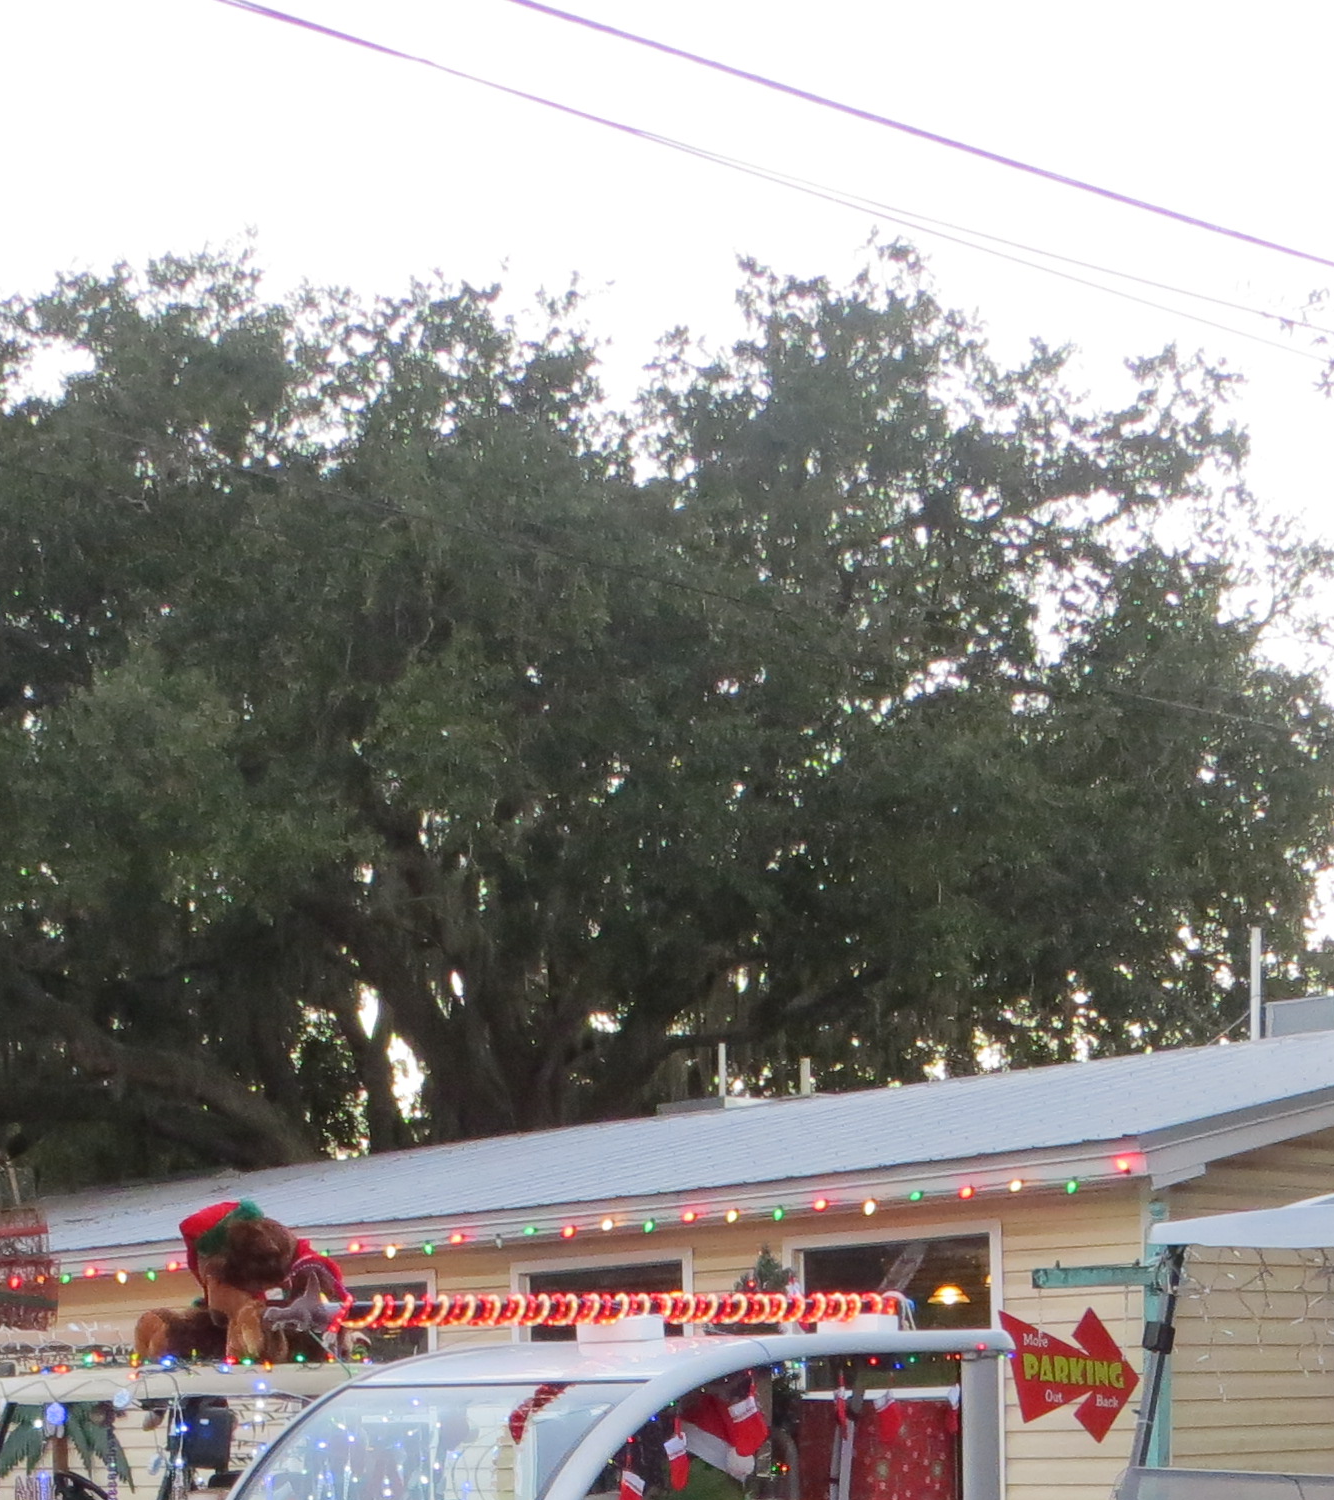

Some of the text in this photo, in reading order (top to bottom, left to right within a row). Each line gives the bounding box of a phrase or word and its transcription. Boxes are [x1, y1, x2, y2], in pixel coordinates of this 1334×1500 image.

[1023, 1333, 1049, 1348] More
[1022, 1353, 1125, 1389] PARKING
[1045, 1389, 1119, 1408] Out Back
